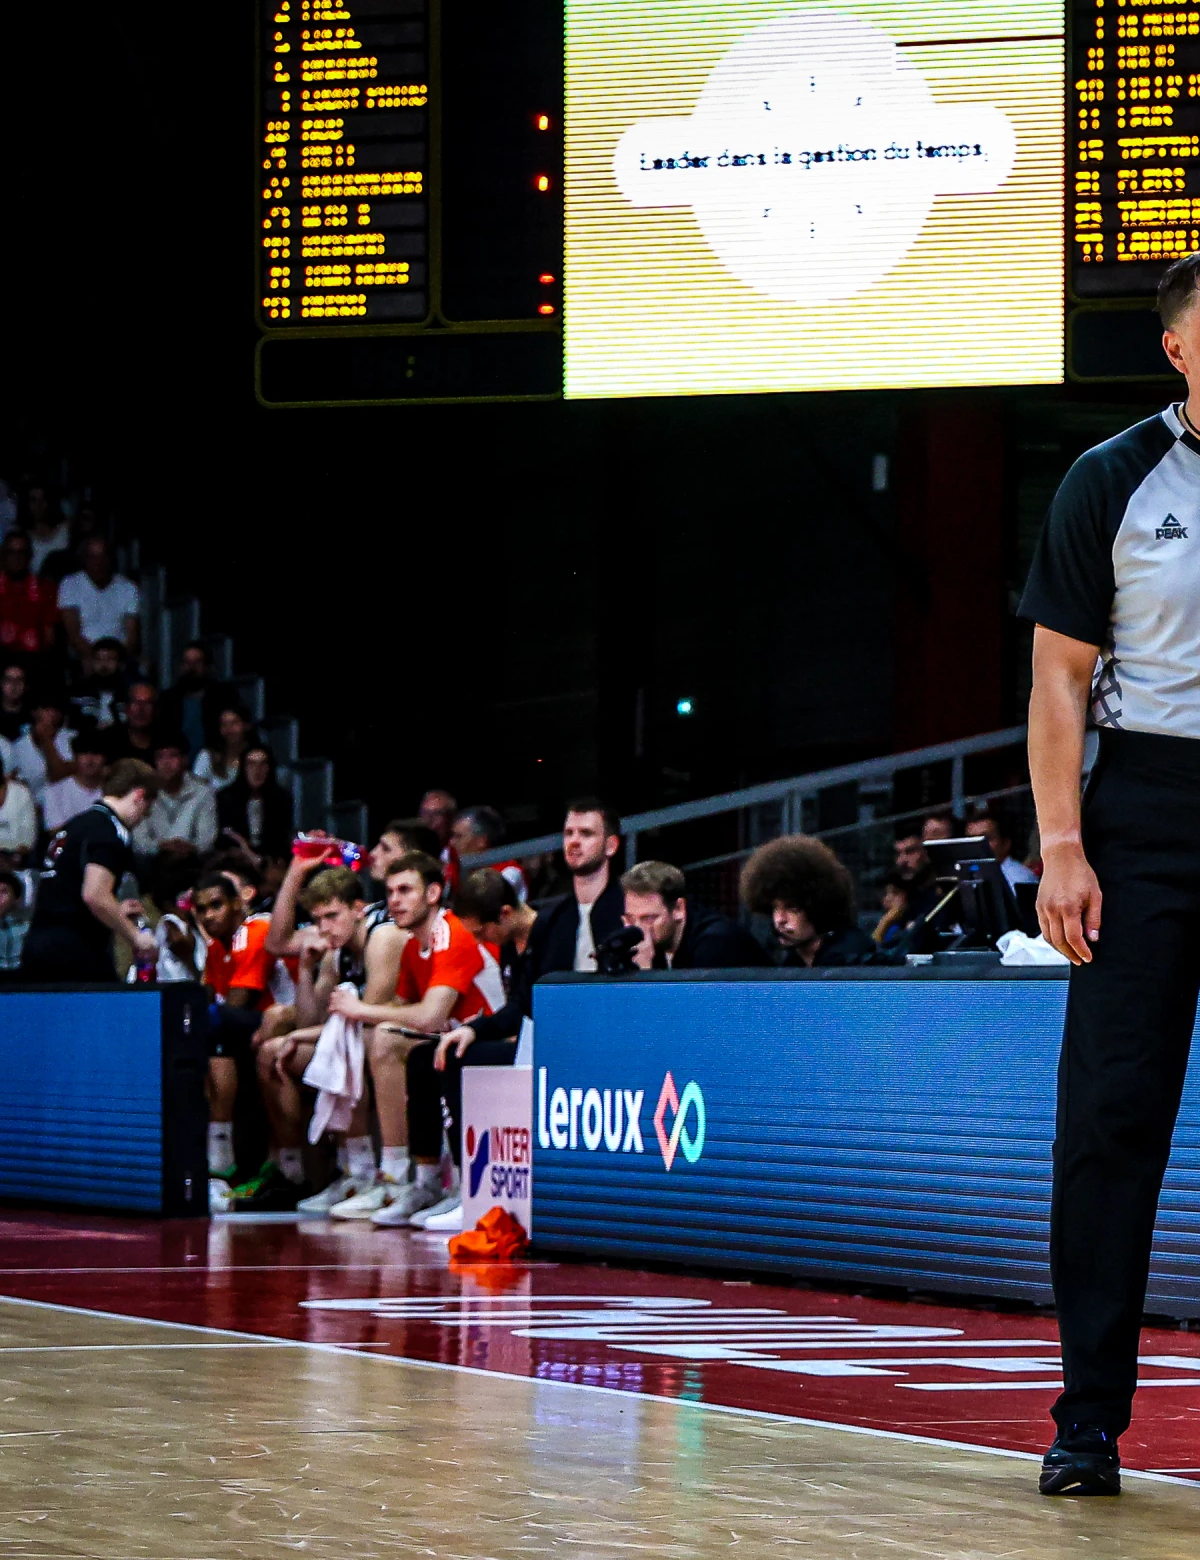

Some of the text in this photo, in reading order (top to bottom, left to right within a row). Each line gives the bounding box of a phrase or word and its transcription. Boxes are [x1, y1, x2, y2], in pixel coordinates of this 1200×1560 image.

[1155, 527, 1188, 540] PEAK
[538, 1066, 644, 1153] leroux
[491, 1126, 529, 1164] INTER
[491, 1166, 529, 1199] SPORT
